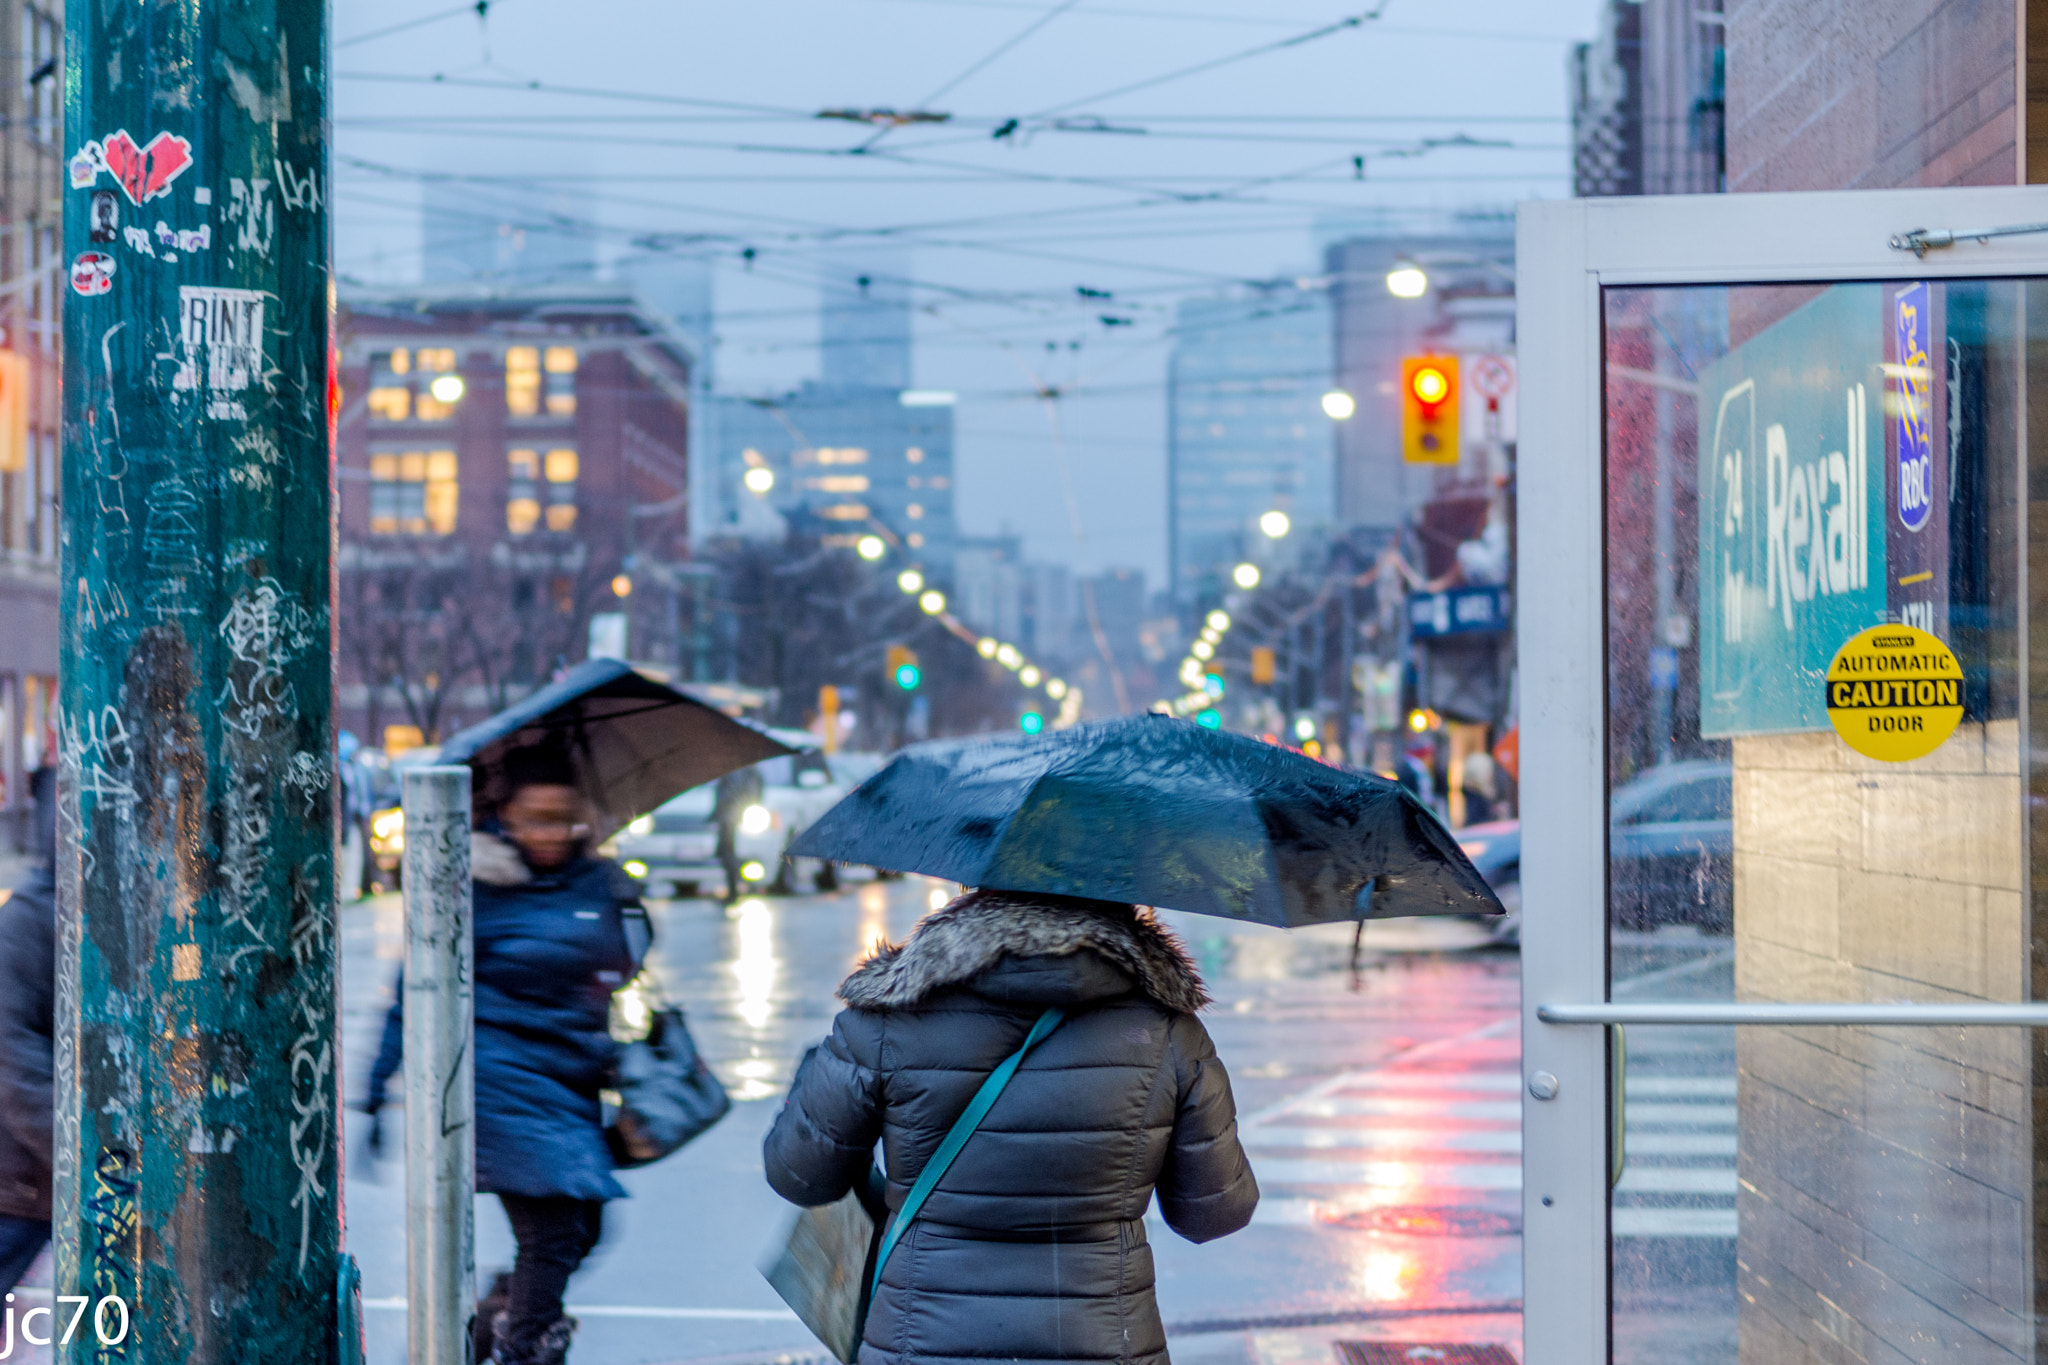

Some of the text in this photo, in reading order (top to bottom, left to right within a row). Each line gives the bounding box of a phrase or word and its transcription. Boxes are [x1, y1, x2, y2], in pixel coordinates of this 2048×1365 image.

[1723, 449, 1743, 537] 24
[1901, 454, 1929, 512] RBC
[1766, 382, 1868, 632] Rexall
[1838, 654, 1951, 673] AUTOMATIC
[1832, 680, 1958, 708] CAUTION
[1869, 715, 1924, 733] DOOR
